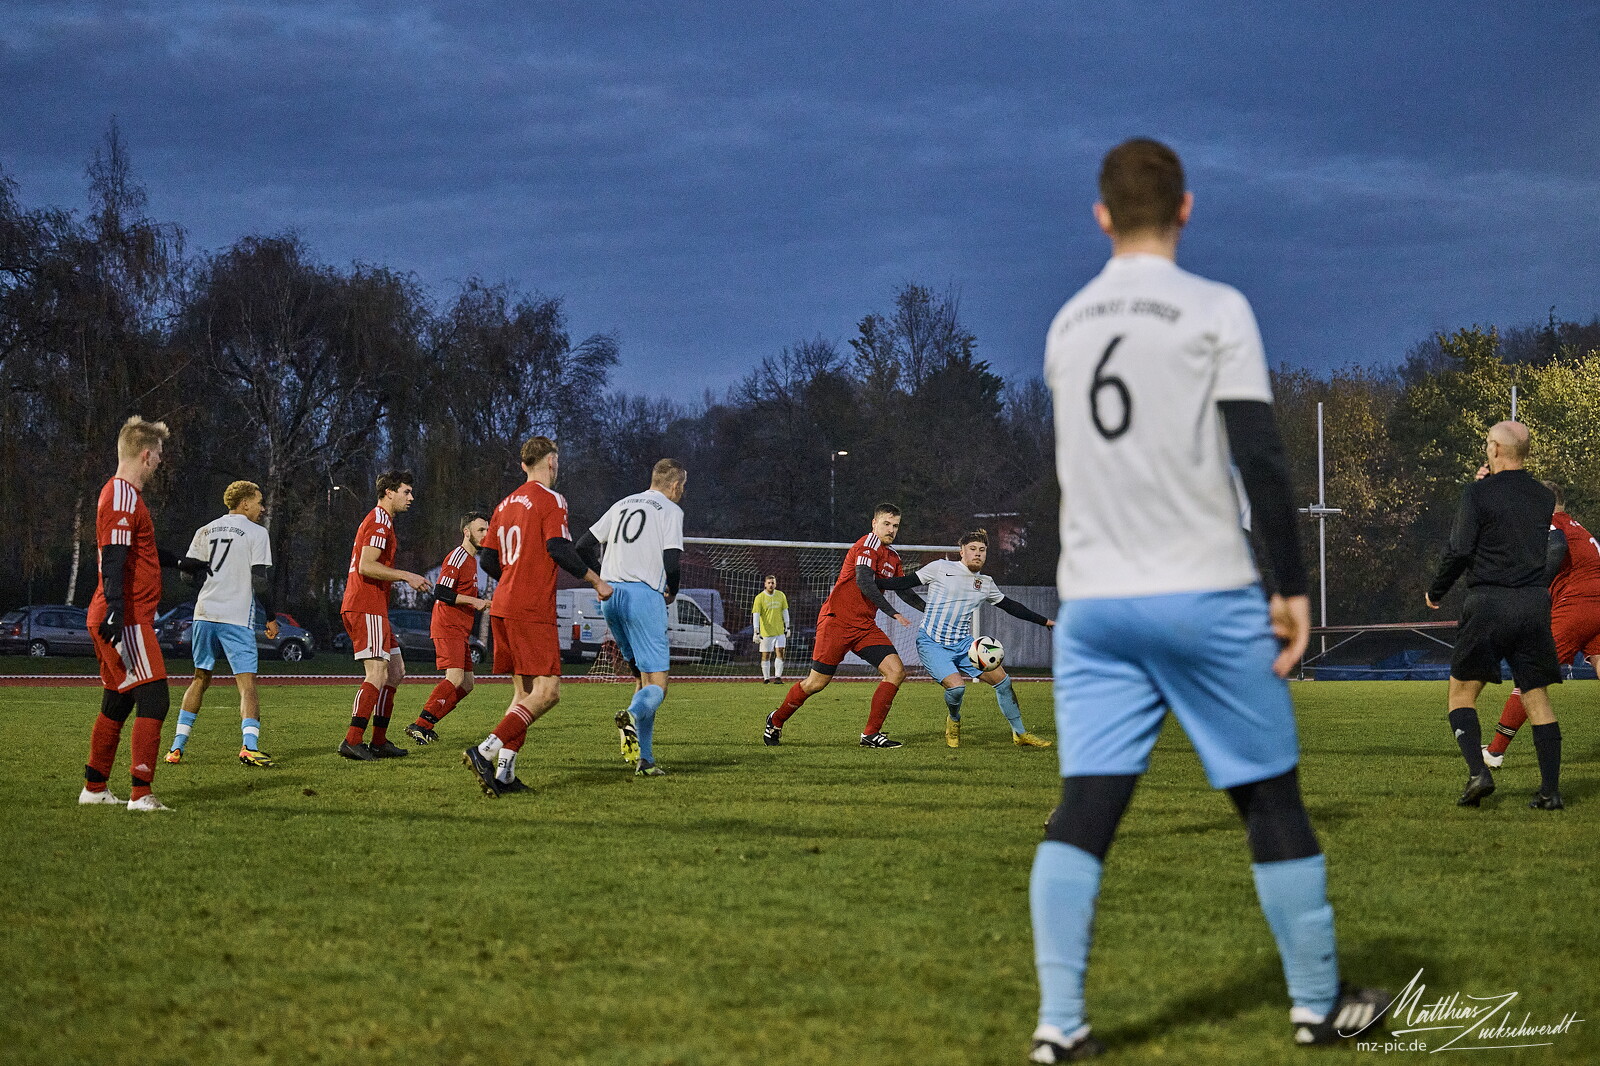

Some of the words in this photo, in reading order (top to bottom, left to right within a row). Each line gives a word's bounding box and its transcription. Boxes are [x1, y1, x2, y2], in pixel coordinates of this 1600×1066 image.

[1089, 332, 1131, 441] 6
[613, 508, 647, 544] 10
[208, 538, 234, 572] 17
[497, 525, 521, 566] 10
